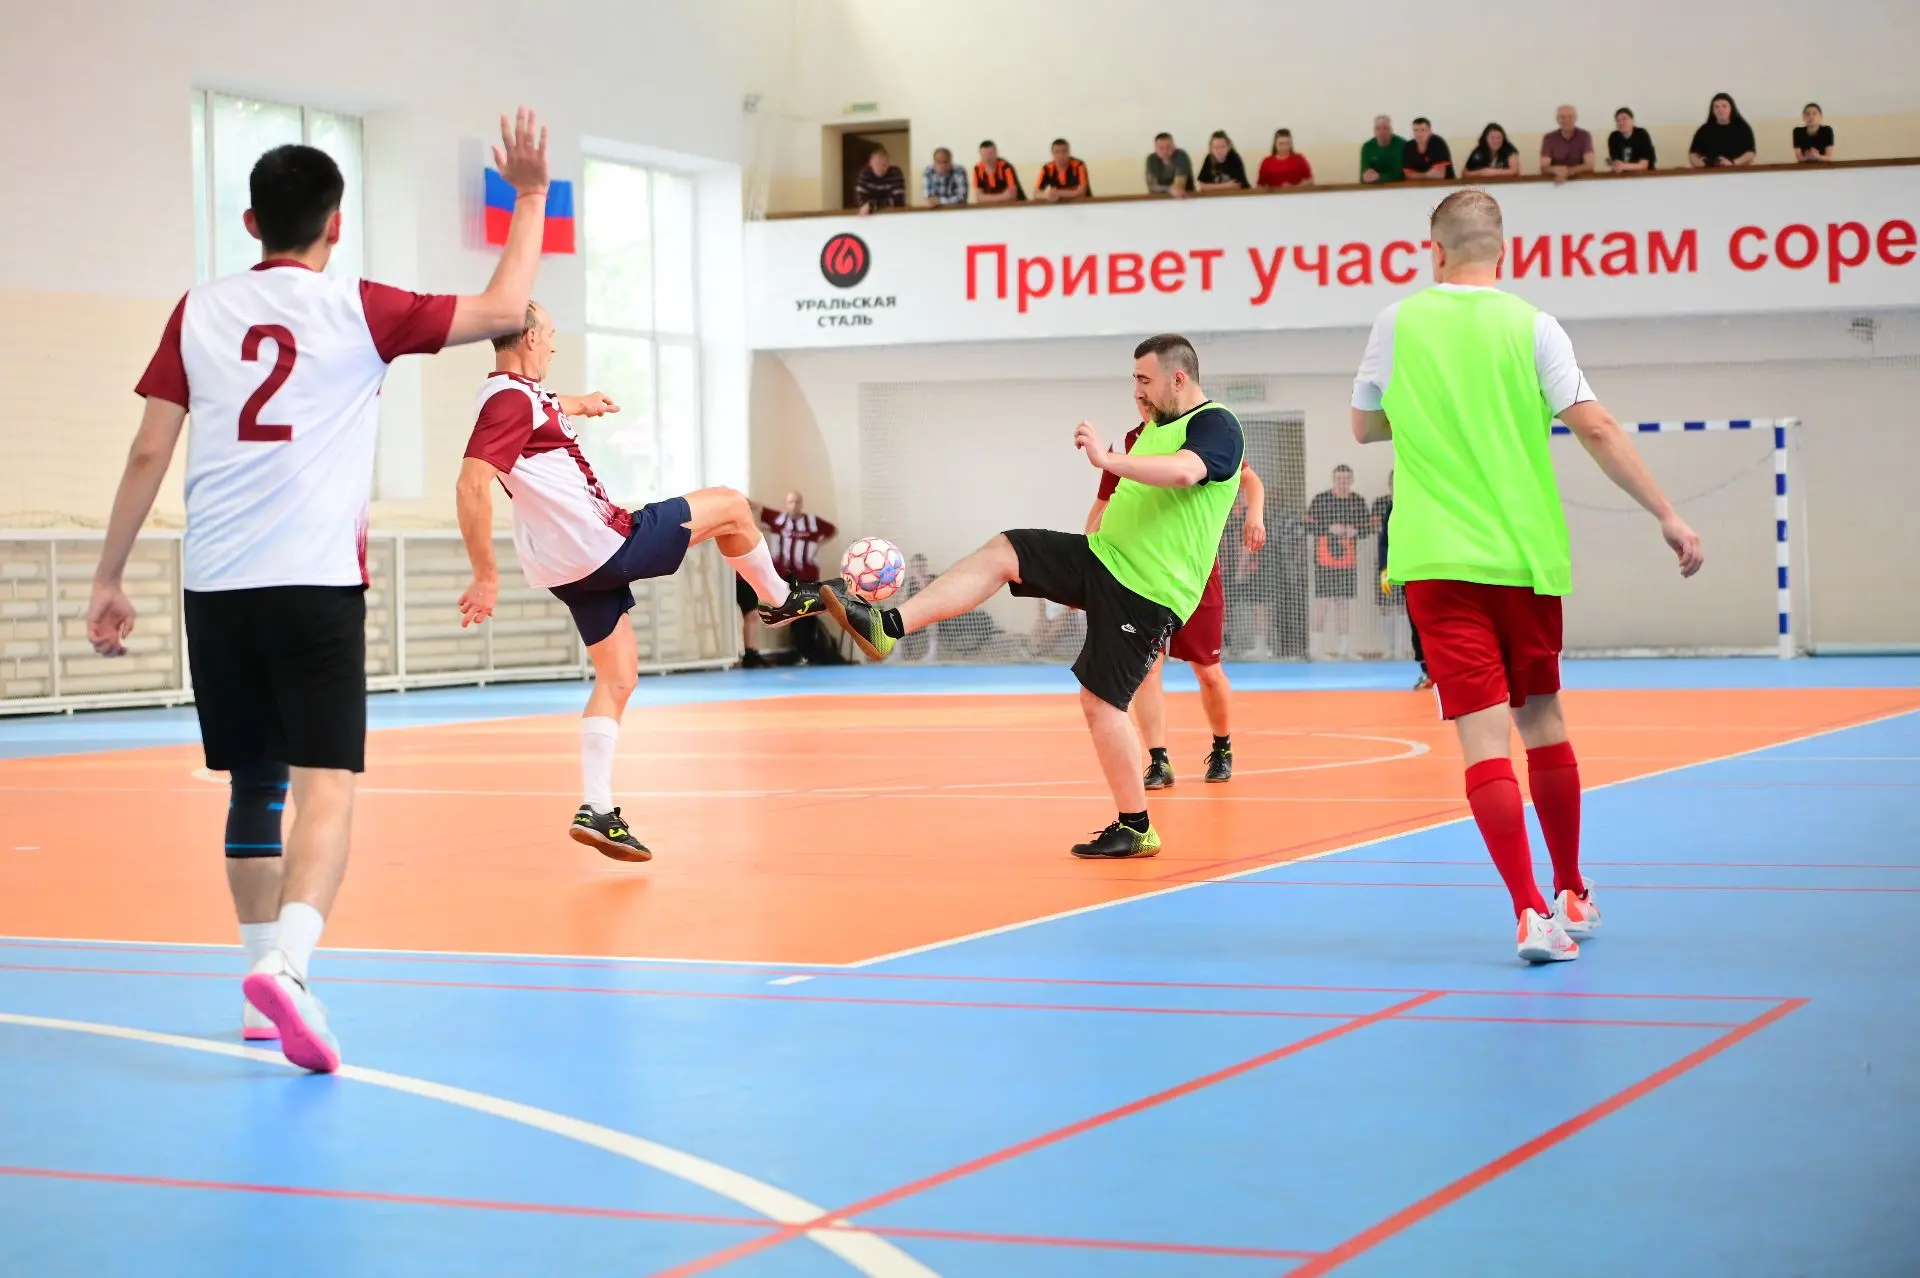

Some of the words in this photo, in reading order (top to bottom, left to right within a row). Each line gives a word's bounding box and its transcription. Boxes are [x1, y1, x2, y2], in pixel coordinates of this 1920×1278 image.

[965, 242, 1225, 314] Привет
[1248, 228, 1698, 306] учасикам
[1728, 218, 1919, 285] соре
[796, 295, 897, 312] УРАЛЬСКАЯ
[817, 313, 873, 328] СТАЛЬ
[237, 324, 297, 442] 2
